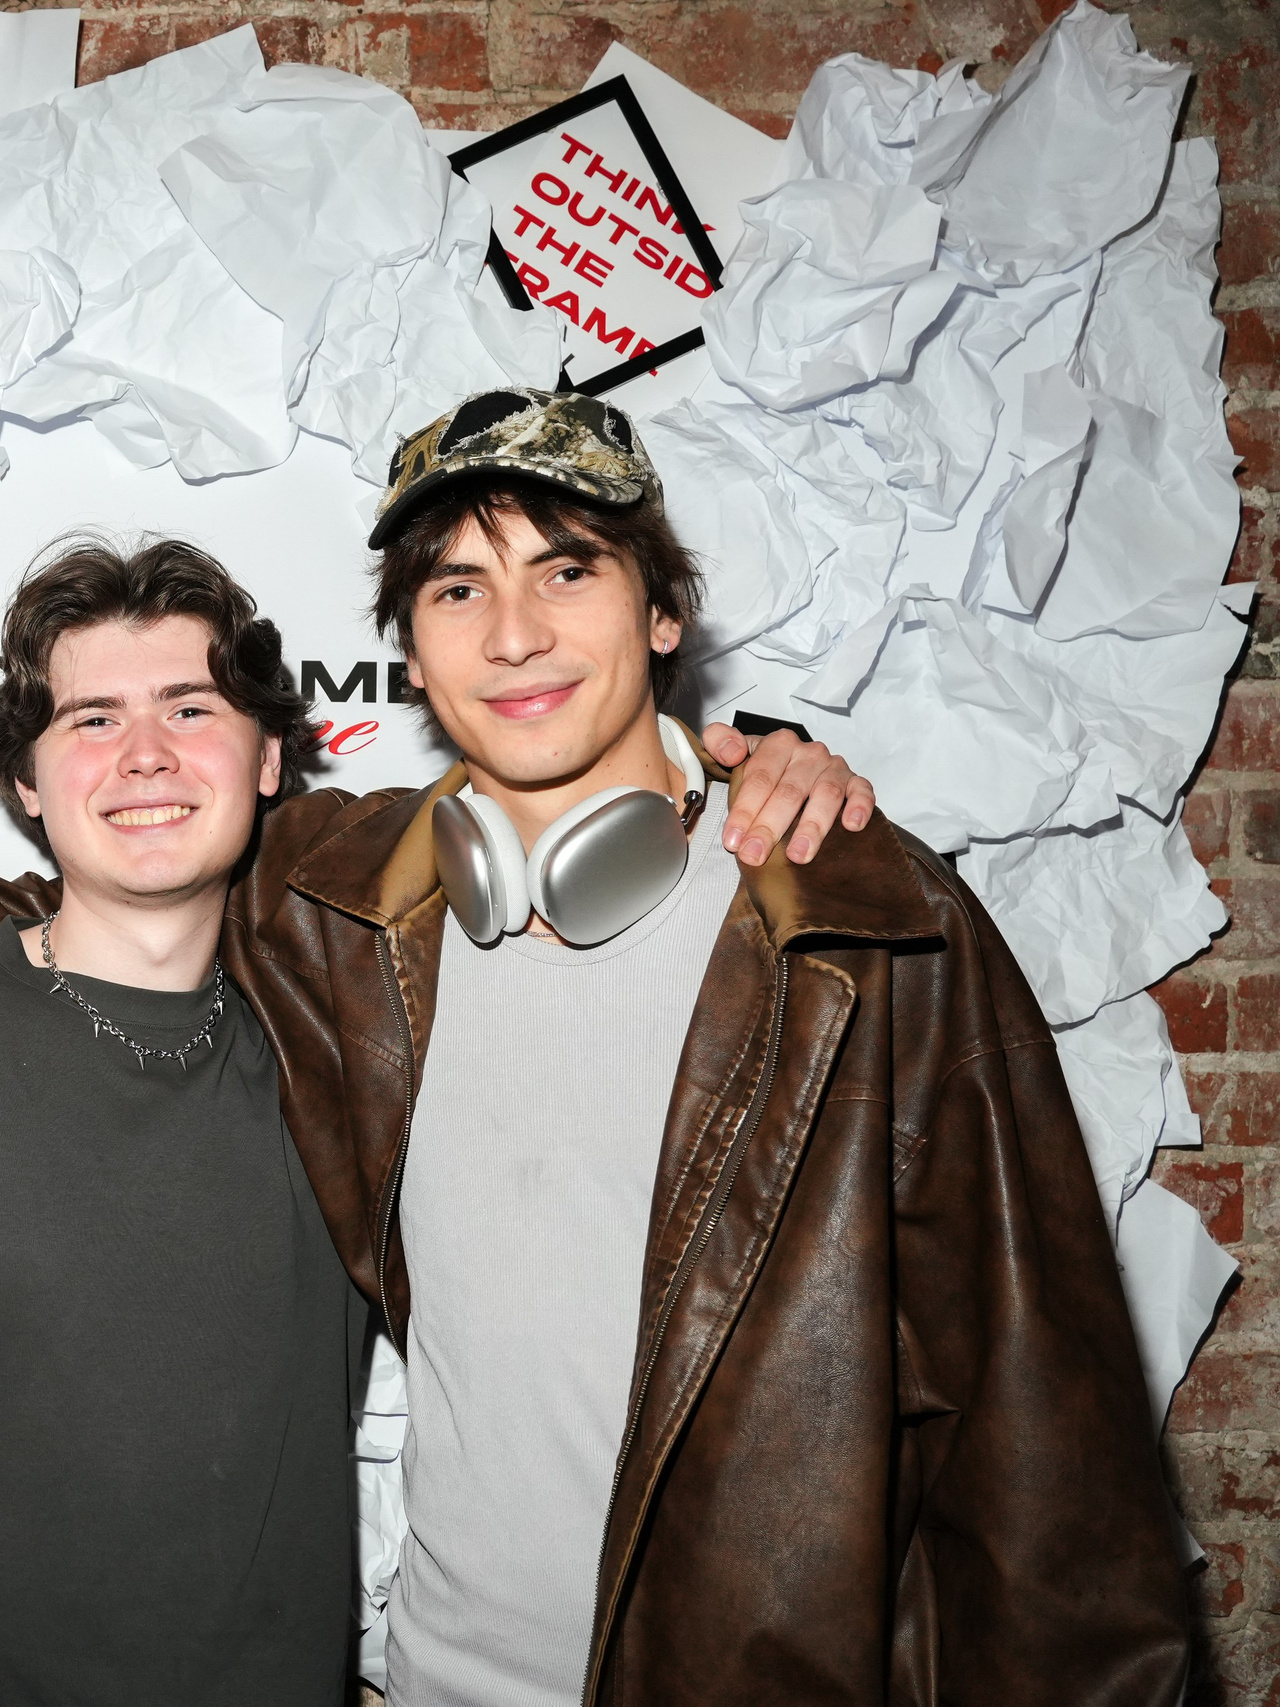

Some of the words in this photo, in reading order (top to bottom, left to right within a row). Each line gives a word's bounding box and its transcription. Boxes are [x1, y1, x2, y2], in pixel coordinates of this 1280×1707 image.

[513, 204, 615, 288] THE
[530, 172, 715, 299] OUTSID
[484, 249, 658, 377] RAM
